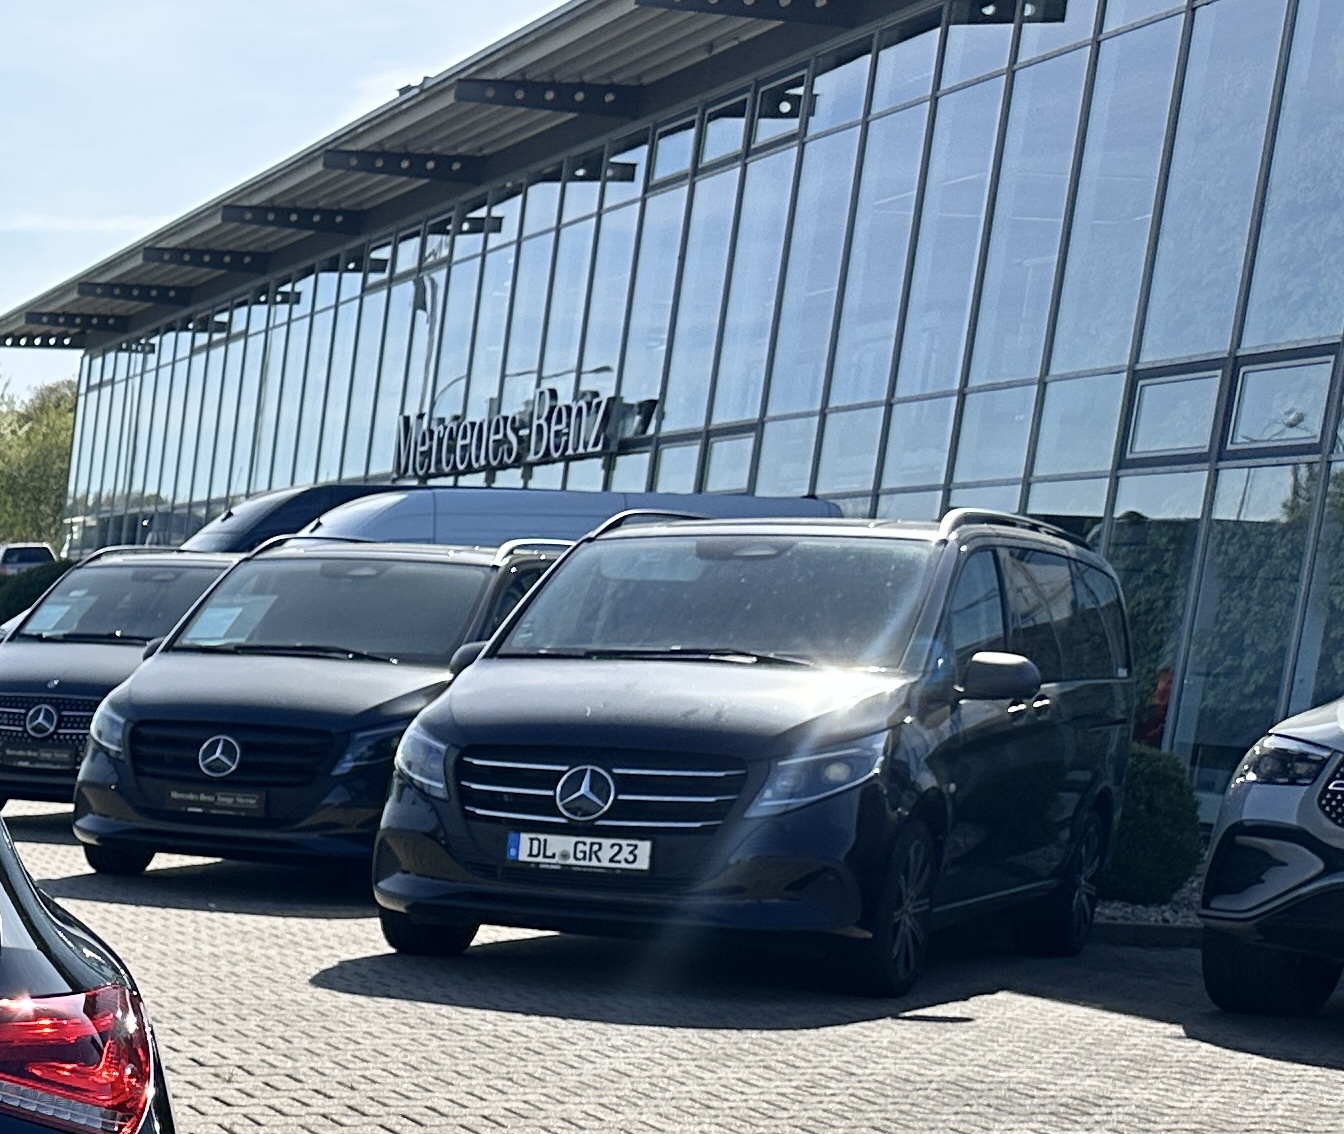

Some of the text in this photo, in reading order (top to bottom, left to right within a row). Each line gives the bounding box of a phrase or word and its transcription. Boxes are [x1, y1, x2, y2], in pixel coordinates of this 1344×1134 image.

[397, 388, 608, 476] Mercedes-Benz
[526, 836, 639, 865] DL GR 23
